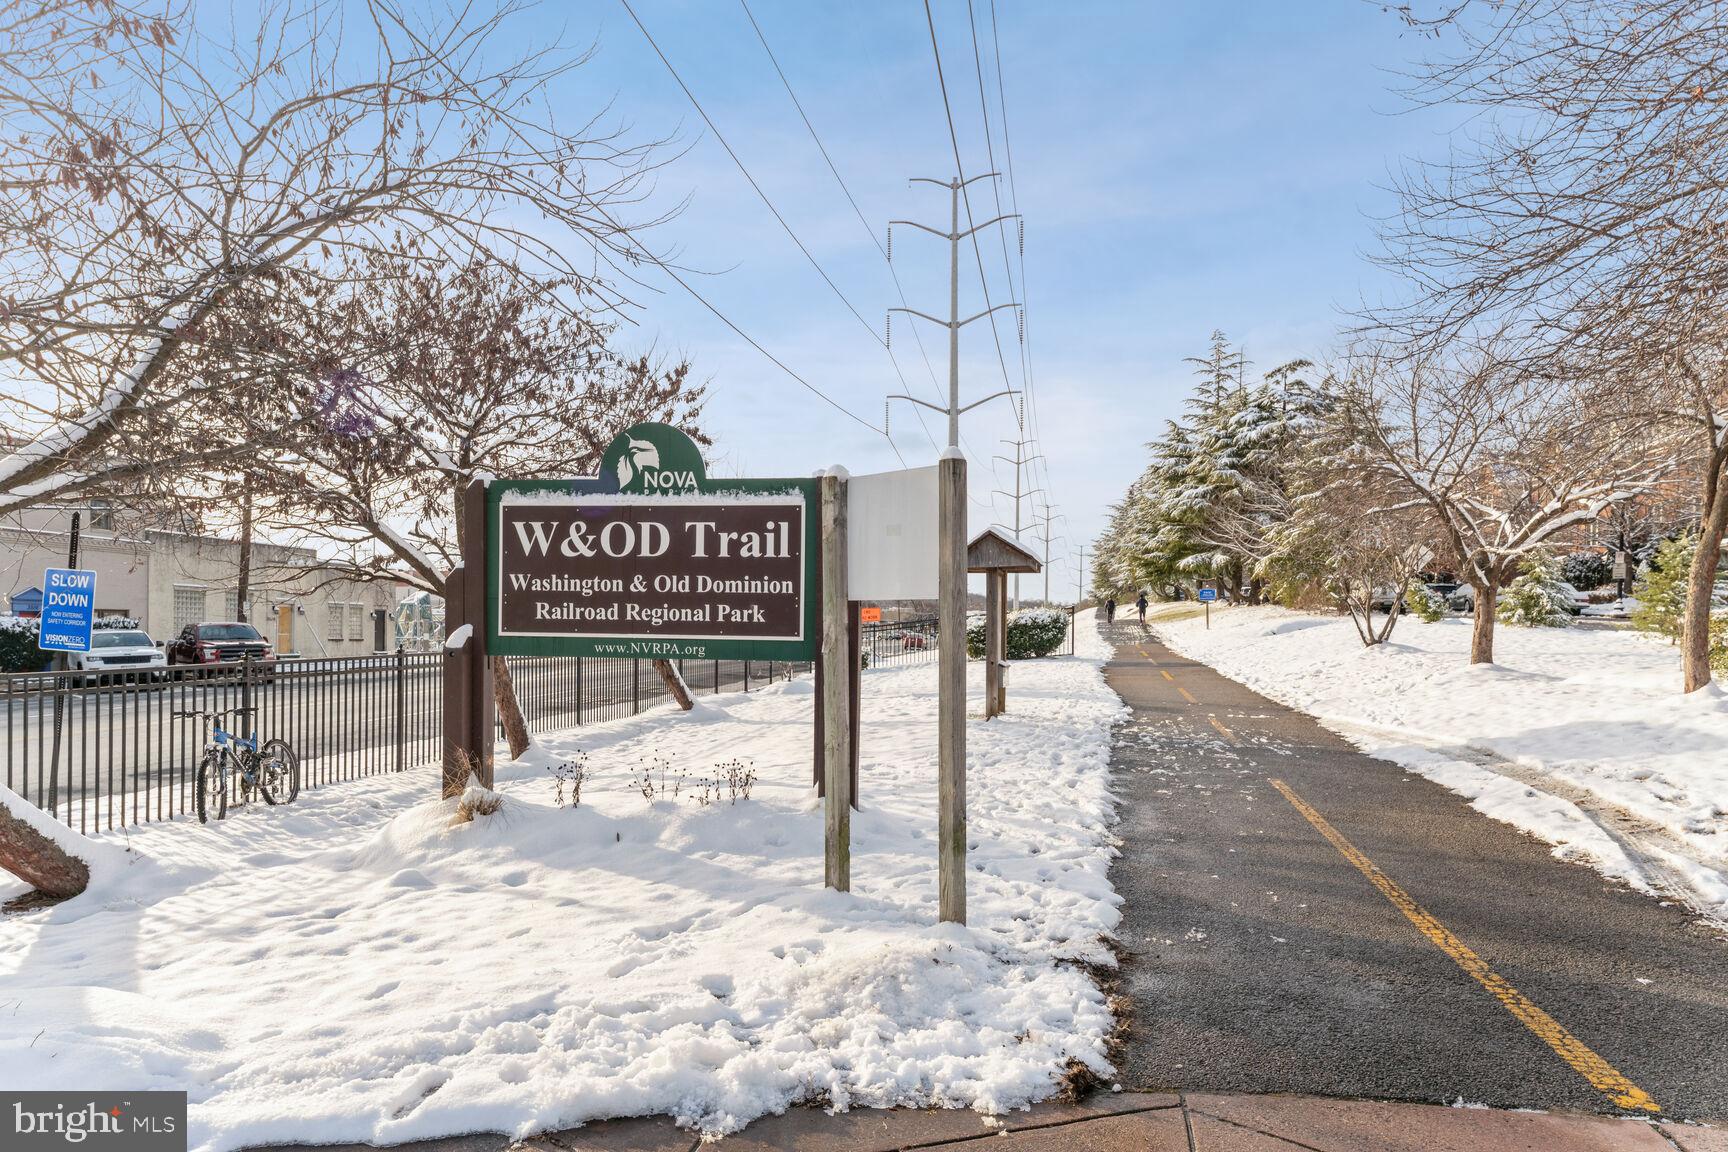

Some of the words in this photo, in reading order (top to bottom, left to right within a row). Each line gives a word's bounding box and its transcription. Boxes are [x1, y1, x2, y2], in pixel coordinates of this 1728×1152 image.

[644, 471, 698, 488] NOVA
[512, 521, 670, 558] W&OD
[685, 521, 791, 558] Trail
[51, 574, 90, 588] SLOW
[509, 574, 623, 597] Washington
[629, 574, 648, 593] &
[654, 574, 690, 593] Old
[696, 575, 793, 594] Dominion
[48, 592, 88, 607] DOWN
[535, 602, 619, 621] Railroad
[625, 603, 710, 626] Regional
[717, 605, 766, 623] Park
[594, 642, 706, 657] www.NVRPA.org
